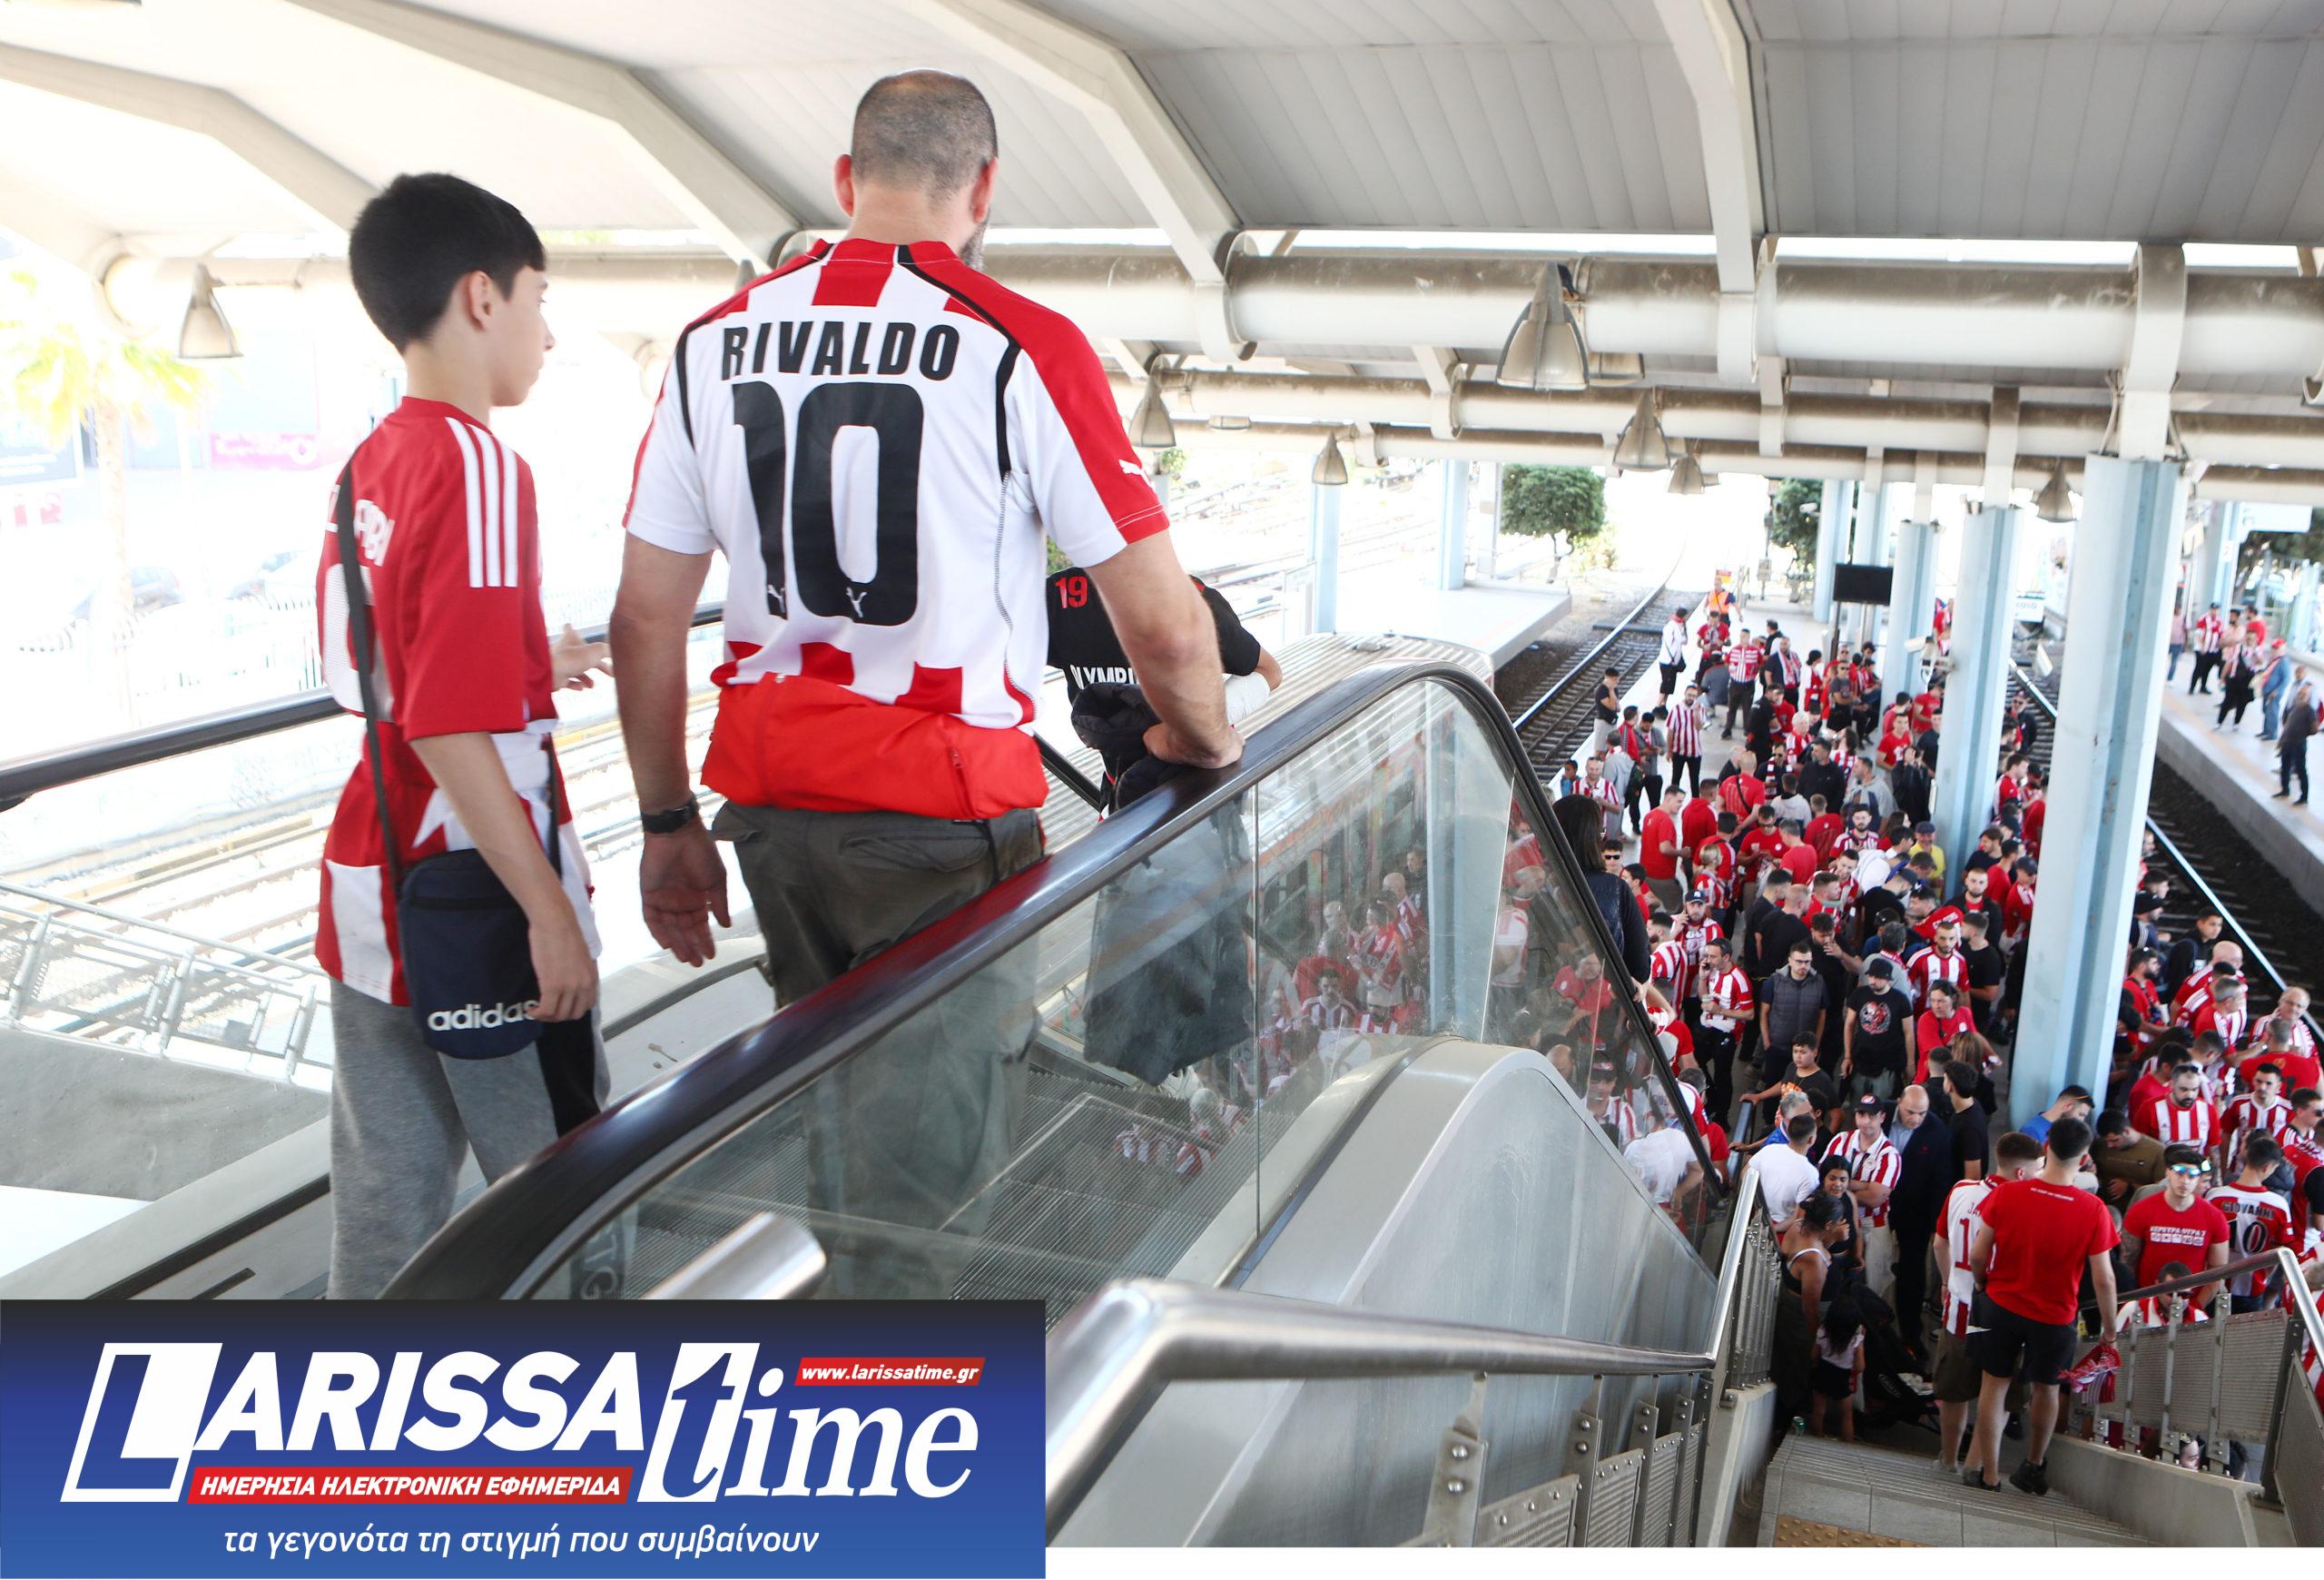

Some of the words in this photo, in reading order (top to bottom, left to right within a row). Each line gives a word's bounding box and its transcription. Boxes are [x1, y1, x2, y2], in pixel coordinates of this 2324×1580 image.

[721, 321, 960, 381] RIVALDO
[731, 380, 925, 627] 10
[1054, 576, 1088, 609] 19
